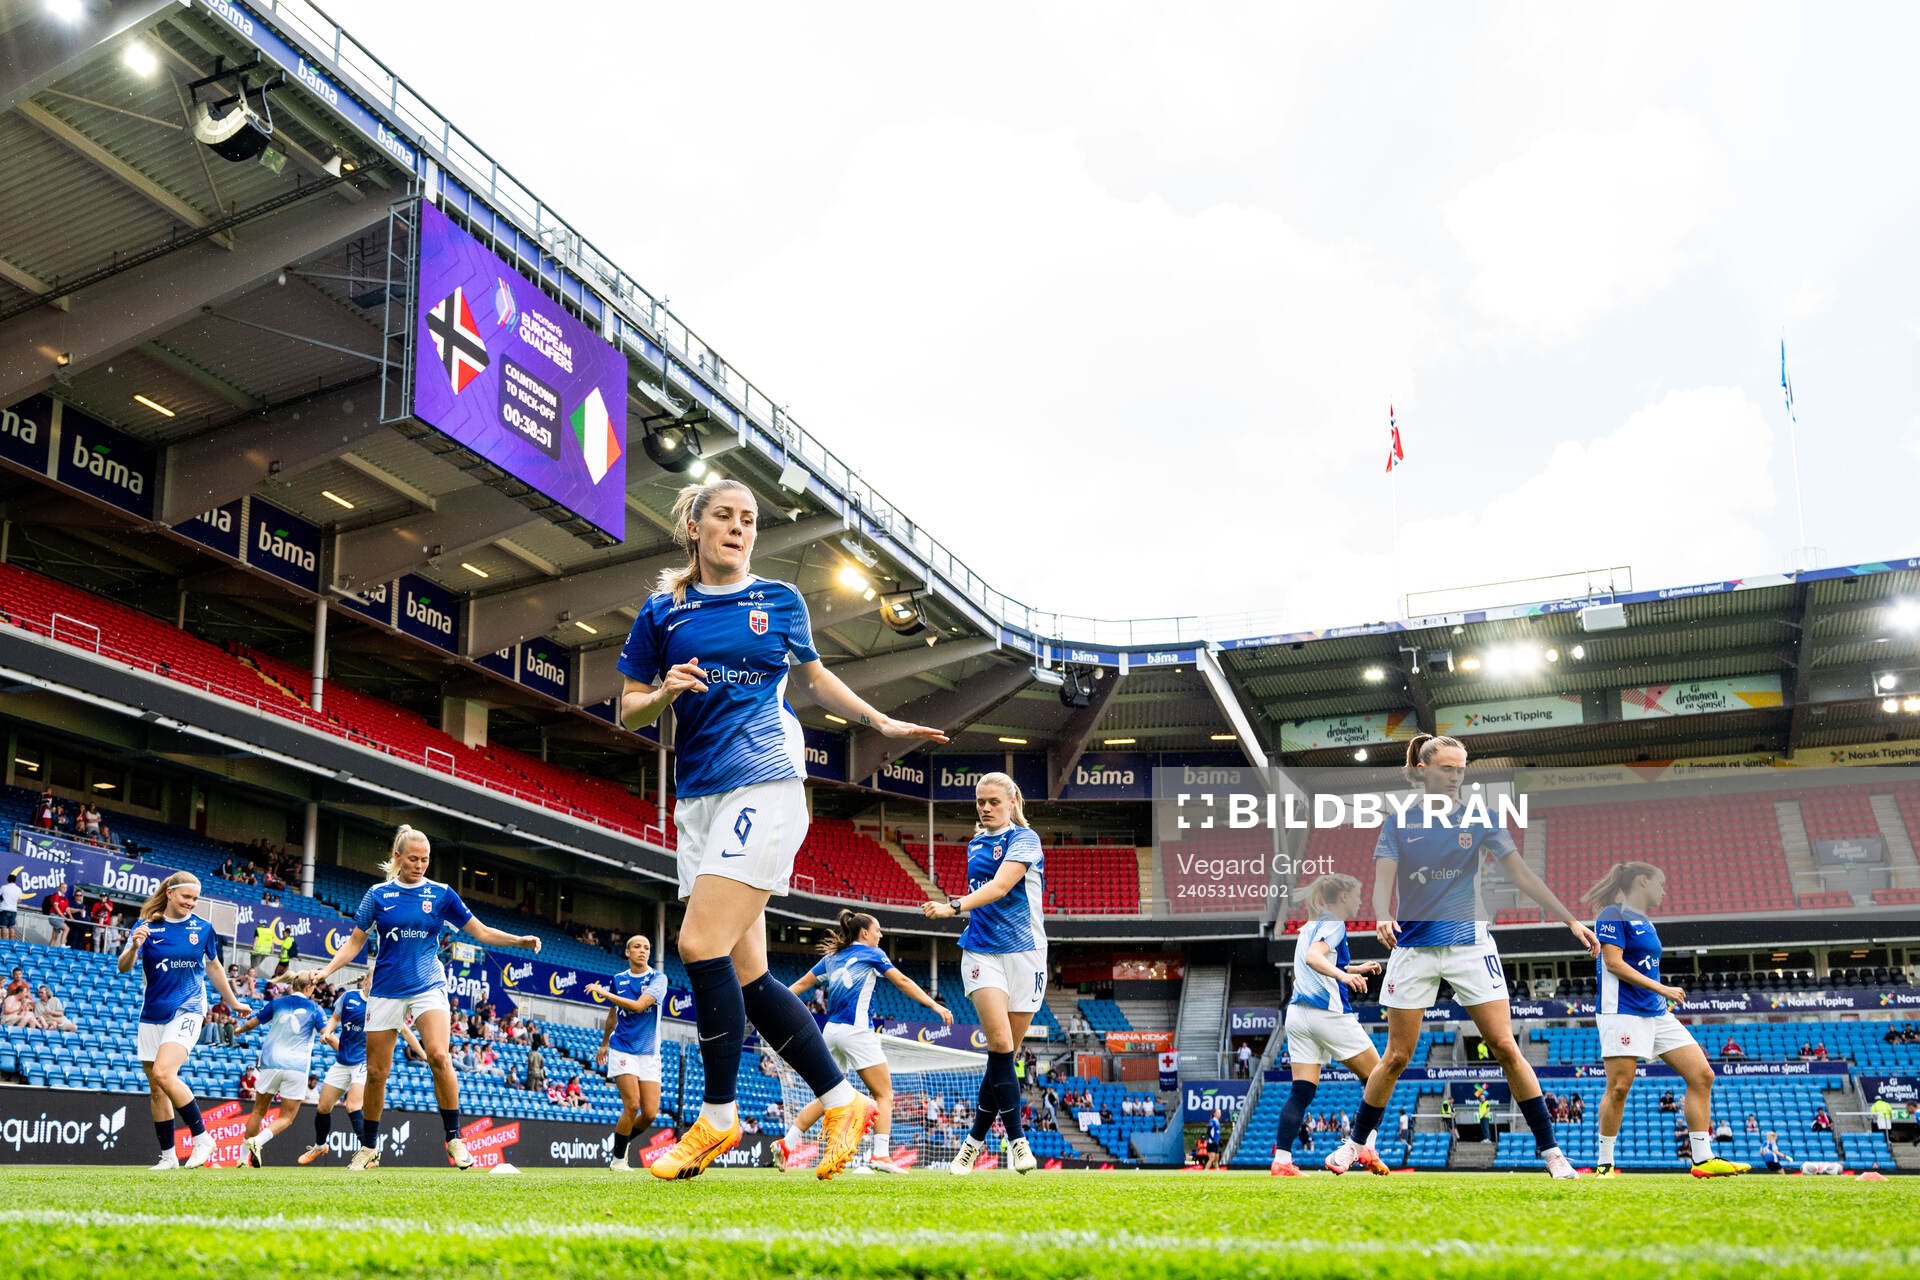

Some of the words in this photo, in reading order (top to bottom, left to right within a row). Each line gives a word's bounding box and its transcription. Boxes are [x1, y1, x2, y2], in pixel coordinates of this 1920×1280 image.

[298, 58, 338, 105] bama
[377, 123, 413, 166] bama
[521, 312, 572, 359] EUROPEAN
[519, 326, 573, 374] QUALIFIERS
[505, 364, 557, 408] COUNTDOWN
[505, 380, 517, 397] TO
[519, 388, 556, 422] KICK-OFF
[0, 409, 37, 445] ma
[503, 403, 552, 448] 00:38:51
[73, 435, 144, 495] bama
[259, 521, 316, 573] bama
[406, 591, 452, 635] bama
[526, 648, 565, 687] bama
[1072, 651, 1099, 663] bama
[1147, 652, 1178, 664] bama
[705, 665, 767, 685] telenor
[1482, 713, 1512, 724] Norsk
[1513, 709, 1553, 722] Tipping
[1848, 750, 1880, 760] Norsk
[1882, 747, 1920, 758] Tipping
[941, 768, 983, 787] bam
[1076, 765, 1134, 786] bama
[1183, 765, 1241, 786] bama
[1558, 773, 1585, 784] Norsk
[734, 807, 756, 847] 6
[21, 867, 66, 891] Bendit
[103, 861, 161, 896] bama
[401, 928, 429, 939] telenor
[510, 962, 533, 981] Bendit
[1484, 954, 1502, 979] 10
[556, 971, 578, 988] Bendit
[1683, 1001, 1710, 1010] Norsk
[1711, 999, 1747, 1011] Tipping
[1787, 998, 1814, 1008] Norsk
[1815, 996, 1854, 1008] Tipping
[1897, 993, 1920, 1004] Nors
[1425, 1008, 1450, 1019] ipping
[1511, 1005, 1544, 1016] Tipping
[1232, 1013, 1278, 1030] bama
[925, 1025, 952, 1041] Bendit
[1427, 1068, 1435, 1079] Gi
[1723, 1064, 1733, 1075] Gi
[1770, 1064, 1781, 1072] en
[1782, 1062, 1810, 1075] sjanse!
[1187, 1090, 1246, 1111] bama
[0, 1113, 93, 1151] quinor
[464, 1128, 516, 1152] RGENDAGENS
[551, 1135, 600, 1164] equinor
[714, 1147, 750, 1168] equinor
[471, 1153, 498, 1168] ELTER
